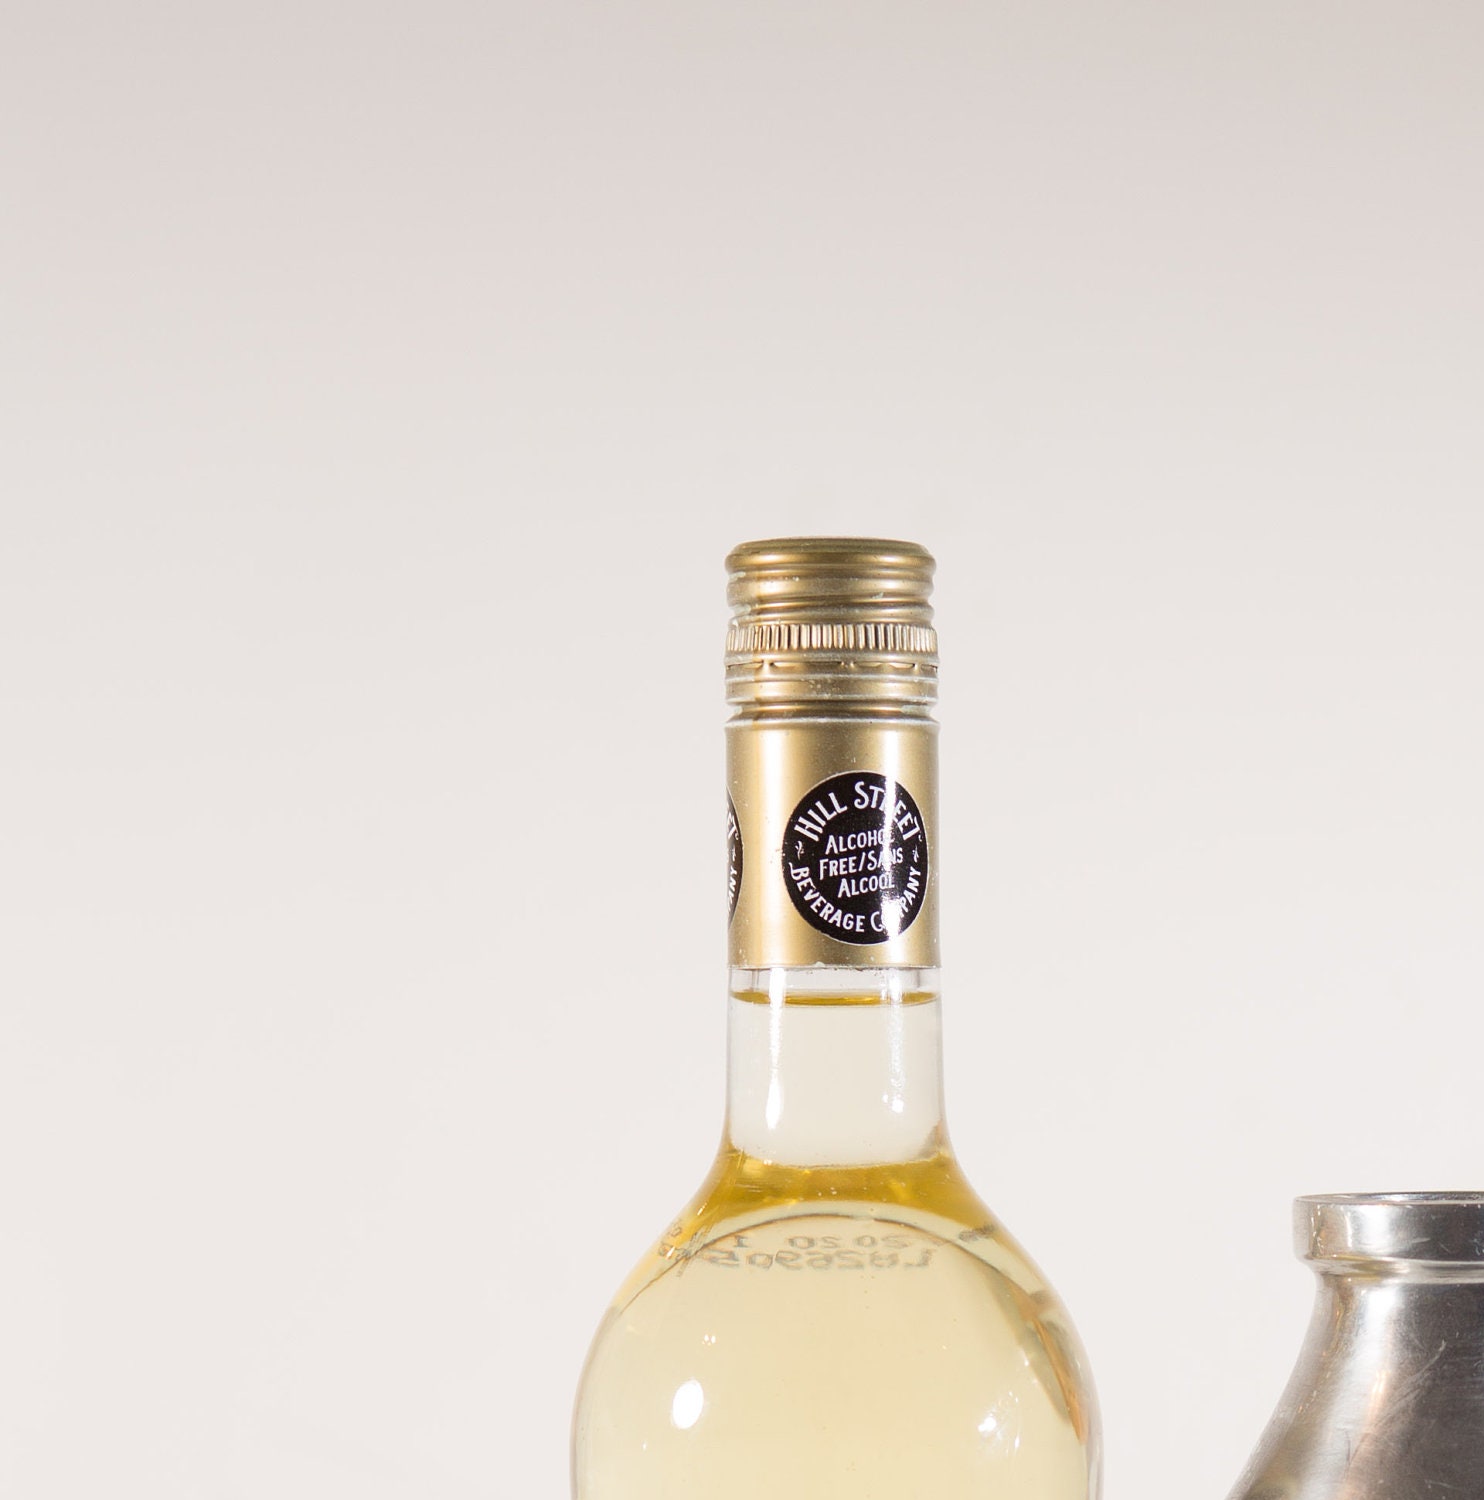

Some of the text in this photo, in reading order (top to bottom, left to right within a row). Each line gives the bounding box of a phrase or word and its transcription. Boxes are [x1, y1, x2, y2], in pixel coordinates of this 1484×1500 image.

[794, 792, 848, 842] HILL
[789, 862, 865, 932] BEVERAGE
[870, 866, 921, 932] CPANY
[838, 872, 895, 898] ALCOOL
